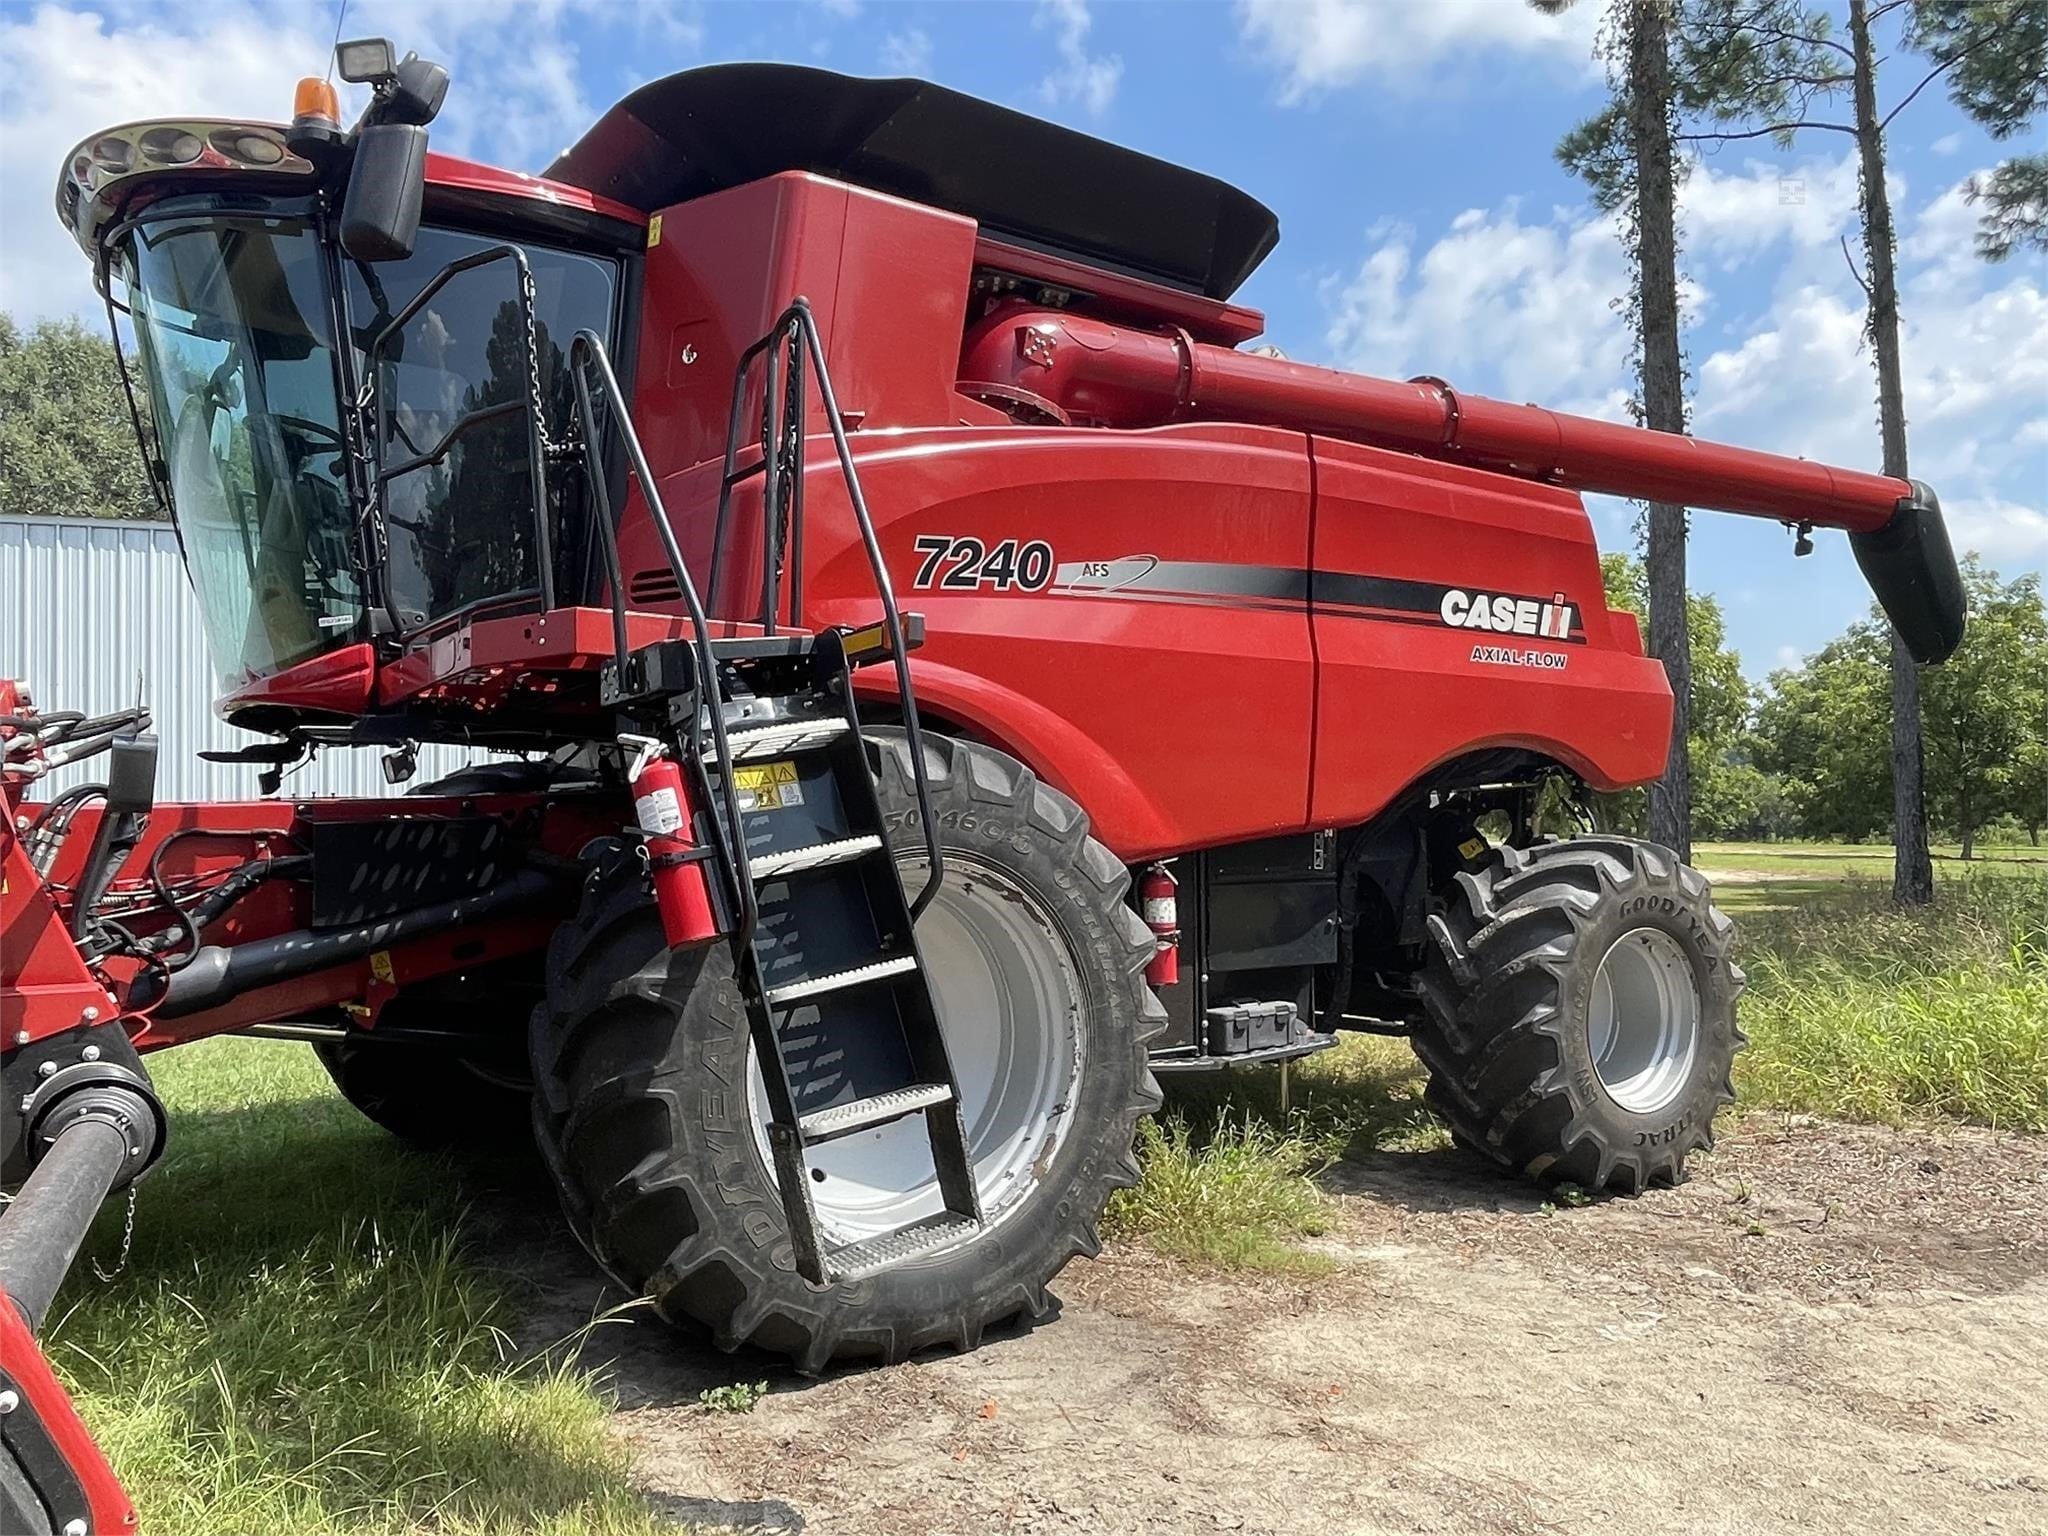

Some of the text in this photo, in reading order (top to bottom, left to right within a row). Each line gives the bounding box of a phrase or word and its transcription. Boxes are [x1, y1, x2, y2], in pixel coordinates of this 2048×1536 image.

[913, 535, 1053, 592] 7240
[1082, 562, 1110, 577] AFS
[1441, 589, 1539, 634] CASE
[1470, 645, 1567, 670] AXIAL-FLOW
[701, 976, 874, 1306] GODYEAR
